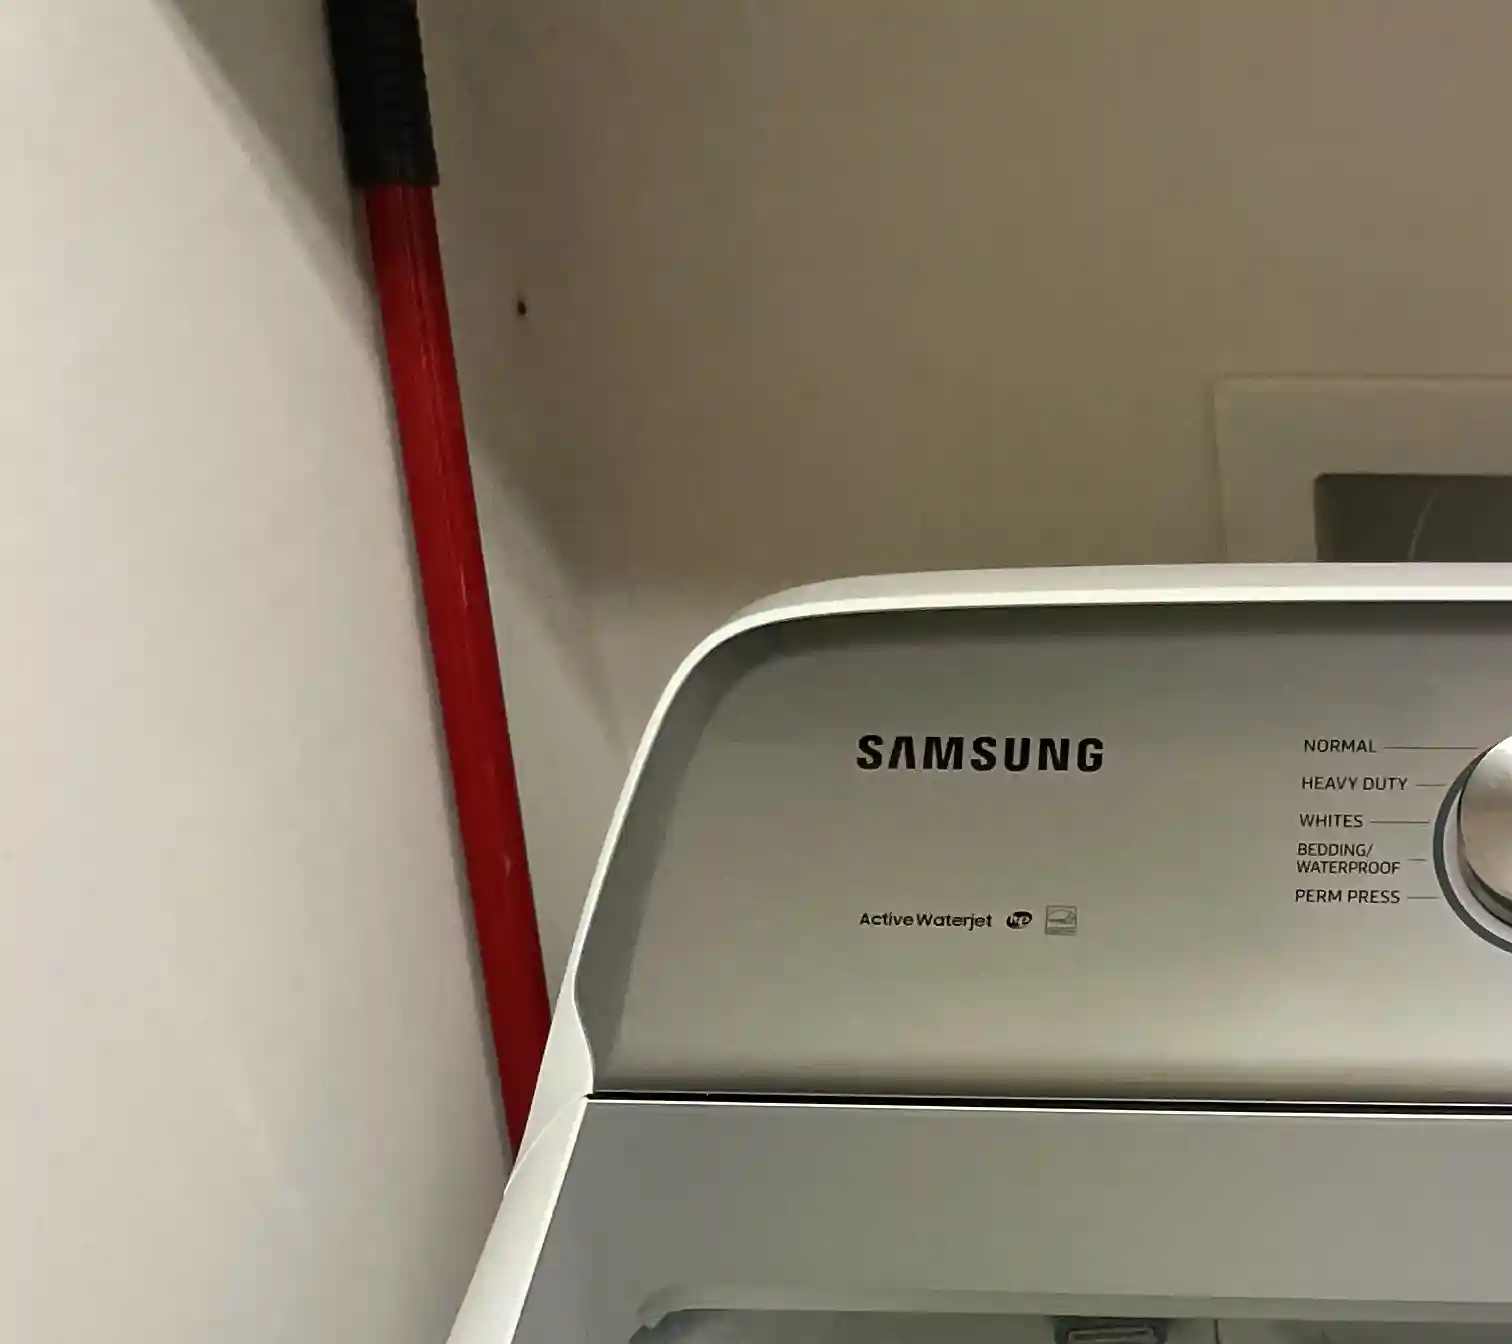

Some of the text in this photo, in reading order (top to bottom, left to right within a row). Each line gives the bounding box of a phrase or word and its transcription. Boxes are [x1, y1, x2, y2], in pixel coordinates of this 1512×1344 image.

[856, 734, 1104, 773] SAMSUNG
[1304, 739, 1377, 753] NORMAL
[1301, 775, 1408, 791] HEAVY DUTY
[1299, 813, 1363, 828] WHITES
[1297, 842, 1374, 858] BEDDING/
[1296, 859, 1401, 875] WATERPROOF
[1295, 888, 1401, 904] PERM PRESS
[859, 911, 914, 927] Active
[916, 913, 993, 932] Waterjet
